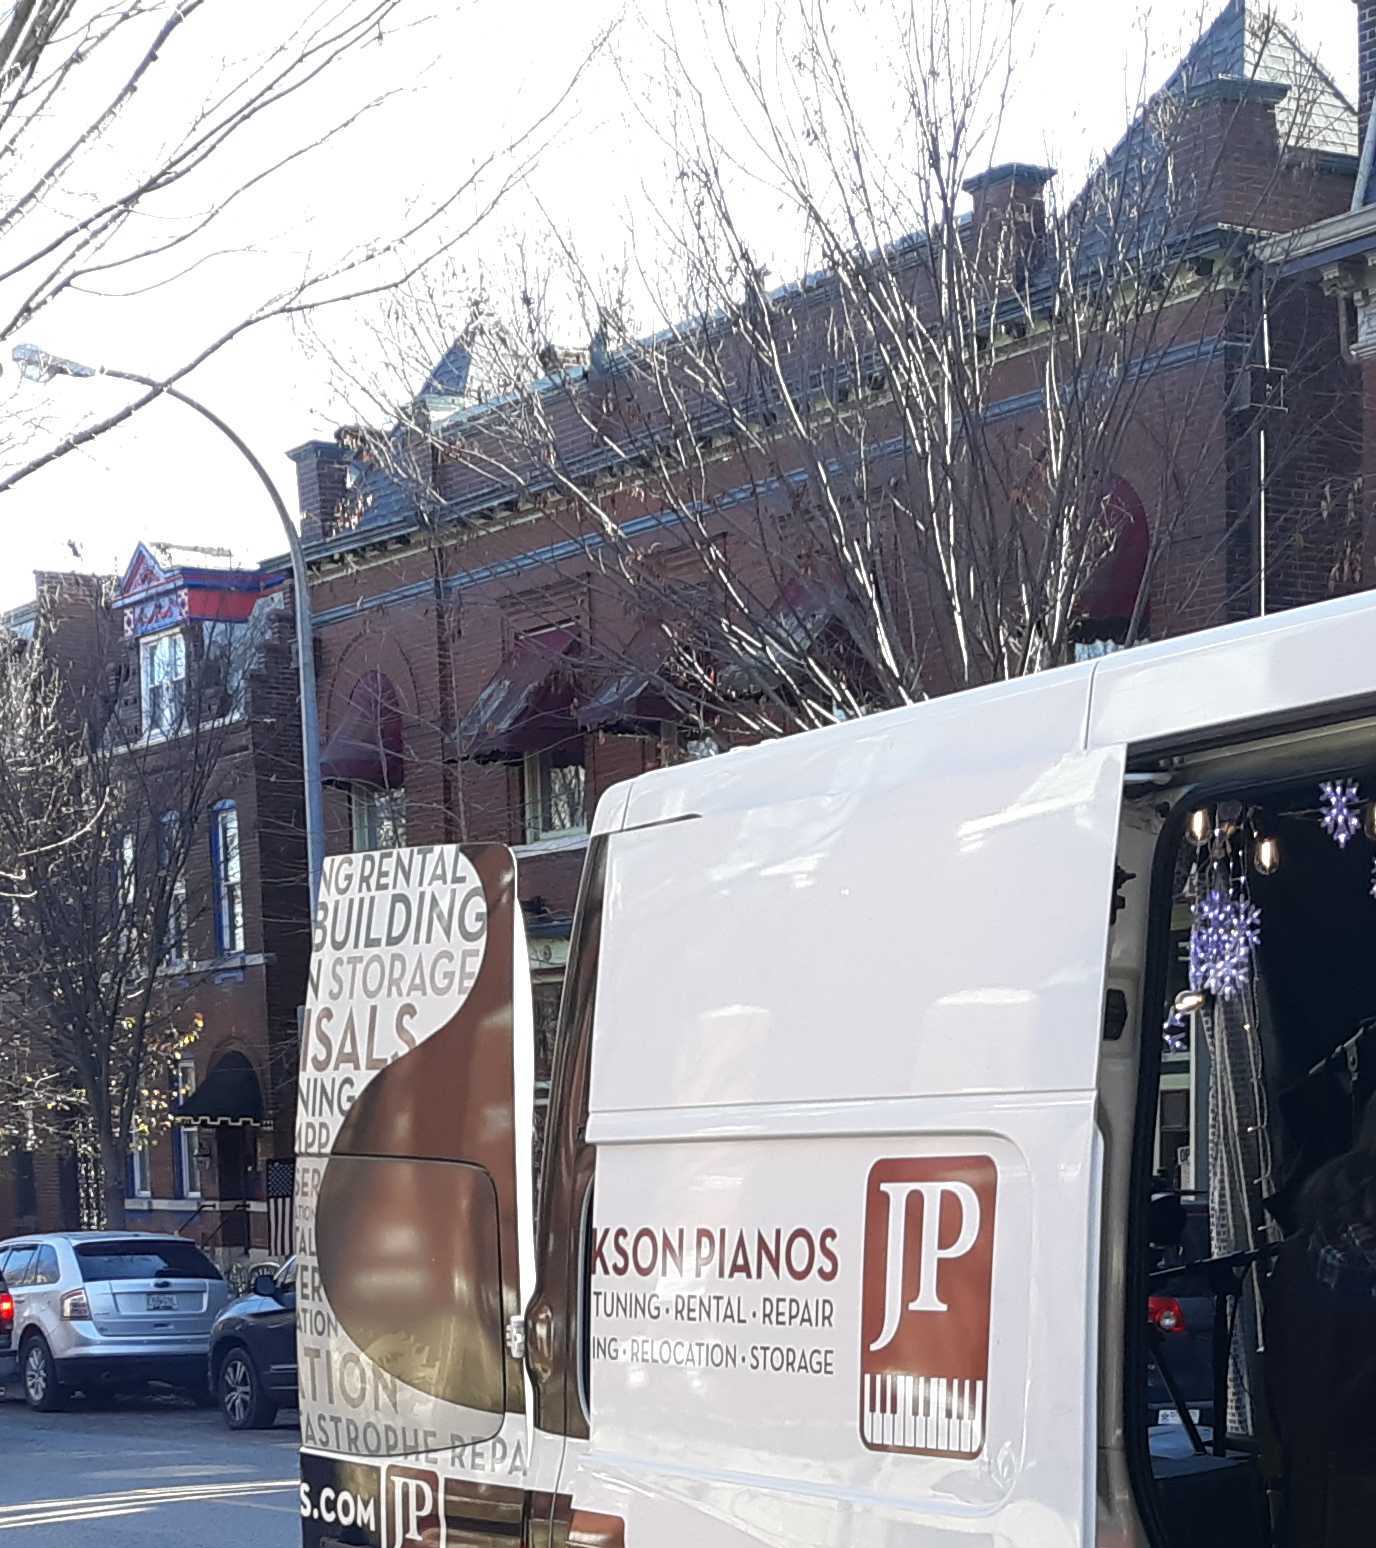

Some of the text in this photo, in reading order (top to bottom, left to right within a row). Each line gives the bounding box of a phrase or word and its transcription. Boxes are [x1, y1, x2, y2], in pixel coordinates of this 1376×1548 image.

[358, 845, 467, 893] RENTAL
[313, 886, 487, 952] BUILDING
[328, 948, 481, 1001] STORAGE
[591, 1227, 839, 1282] KSON PIANOS
[869, 1181, 981, 1352] JP
[593, 1291, 835, 1328] TUNING RENTAL REPAIR
[300, 1346, 400, 1415] TION
[592, 1336, 835, 1375] ING RELOCATION STORAGE
[300, 1411, 437, 1460] ASTROPHE
[299, 1482, 376, 1532] S.COM
